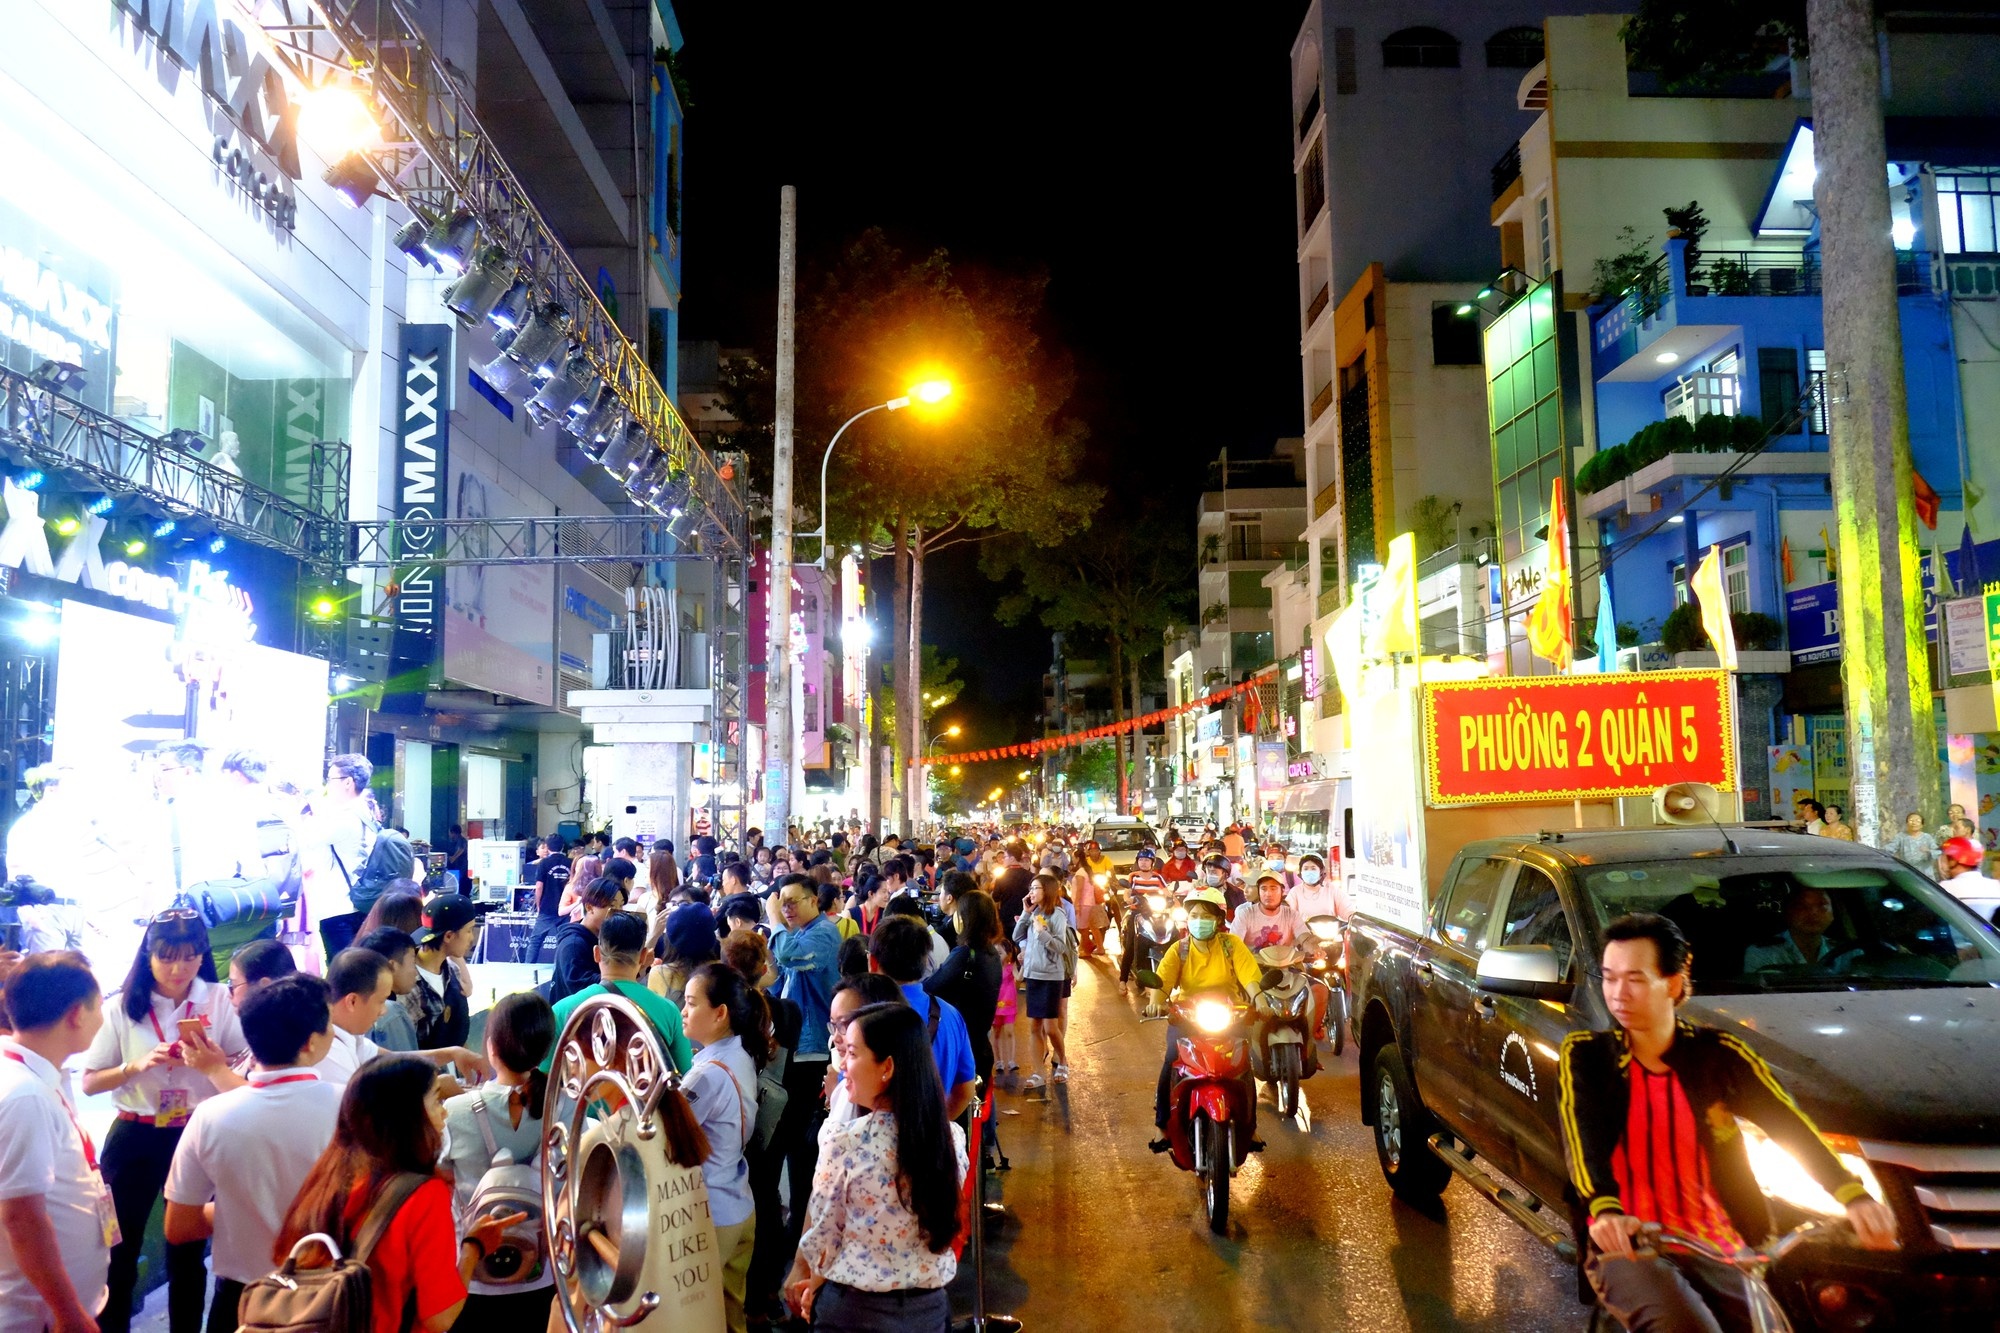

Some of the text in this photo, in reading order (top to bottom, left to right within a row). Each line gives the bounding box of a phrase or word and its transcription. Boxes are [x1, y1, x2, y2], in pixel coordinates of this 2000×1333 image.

[1459, 692, 1698, 776] PHƯỜNG 2 QUẬN 5
[657, 1171, 705, 1203] MAMA
[660, 1200, 711, 1234] DON'T
[668, 1232, 709, 1263] LIKE
[673, 1262, 711, 1293] YOU
